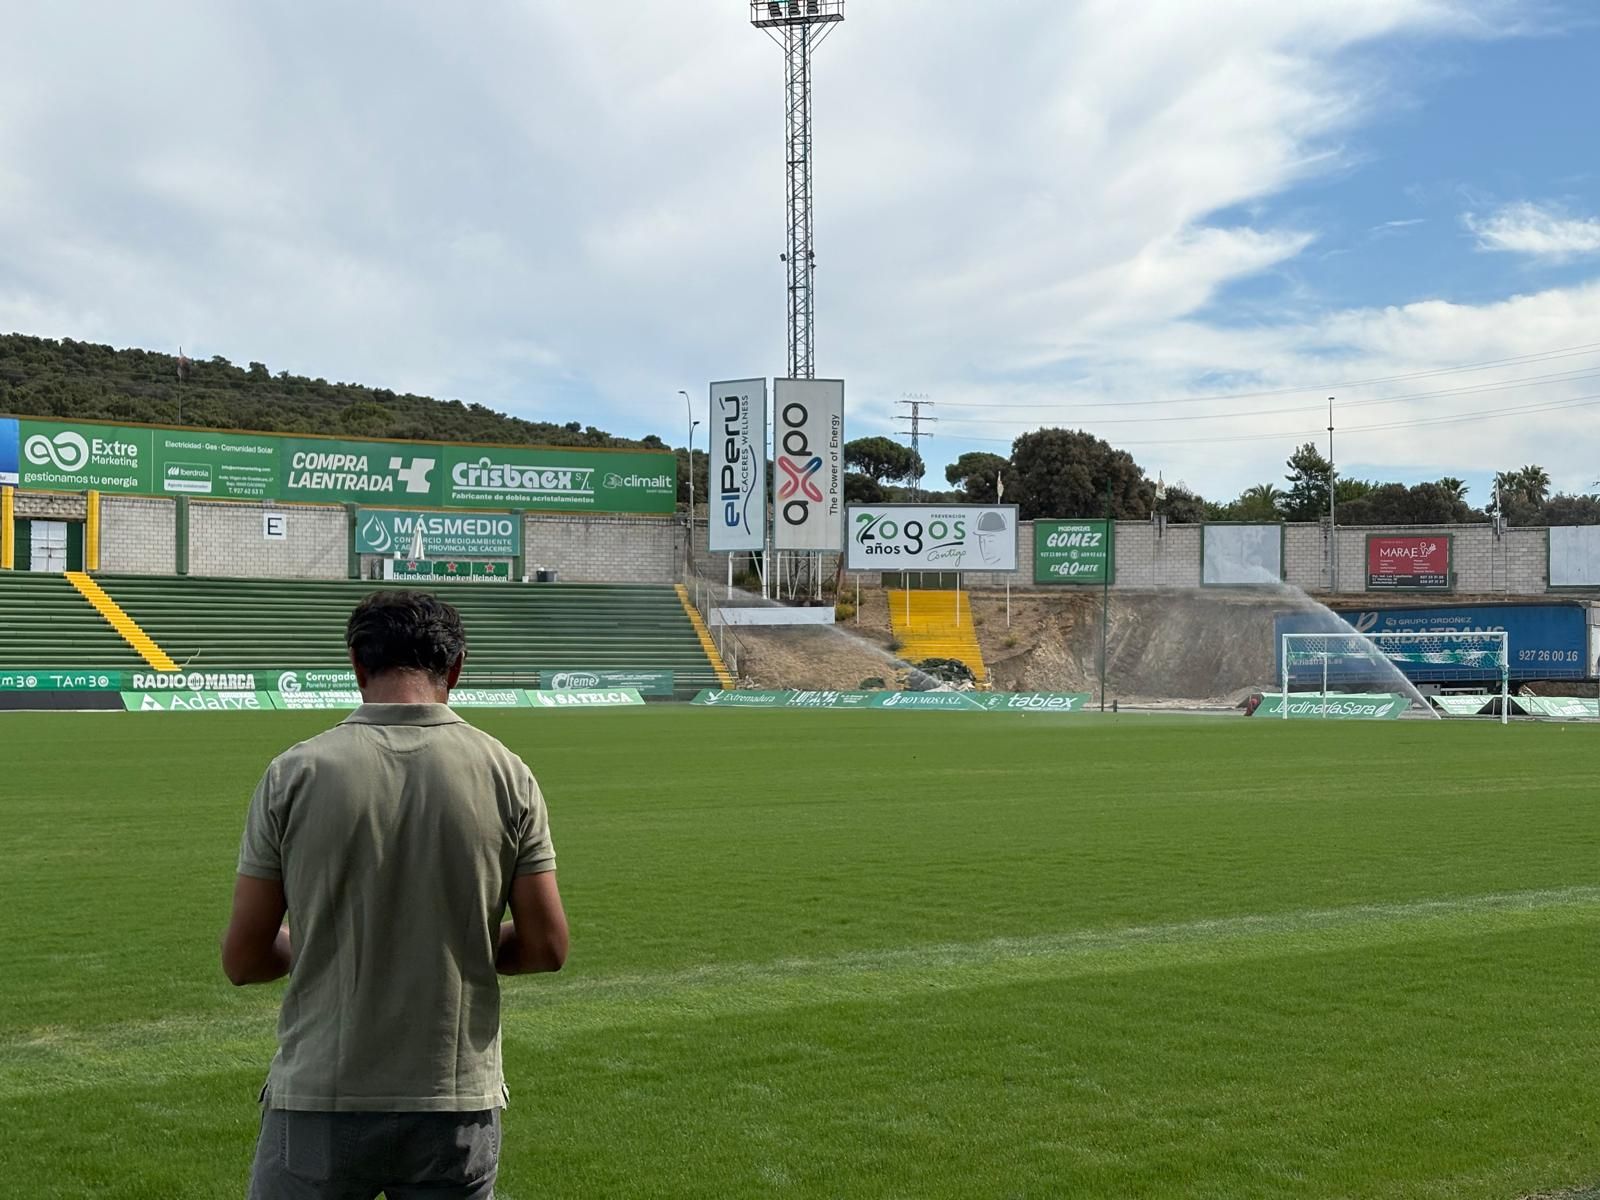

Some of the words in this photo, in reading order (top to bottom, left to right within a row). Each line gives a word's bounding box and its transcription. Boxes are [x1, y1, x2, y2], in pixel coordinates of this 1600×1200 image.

[742, 395, 750, 446] WELLNESS
[829, 413, 841, 451] Energy
[92, 438, 138, 457] Extre
[165, 440, 203, 450] Electricidad
[205, 443, 218, 452] Gas
[221, 444, 257, 454] Comunidad
[257, 446, 274, 455] Solar
[92, 455, 138, 469] Marketing
[292, 451, 368, 472] COMPRA
[829, 451, 838, 462] of
[778, 403, 823, 526] axpo
[24, 471, 89, 485] gestionamos
[89, 475, 101, 485] tu
[101, 476, 138, 490] energía
[180, 469, 209, 478] Iberdrola
[829, 462, 838, 493] Power
[288, 471, 393, 493] LAENTRADA
[623, 475, 673, 489] climalit
[452, 492, 493, 502] Fabricante
[494, 494, 504, 502] de
[504, 495, 531, 503] dobles
[531, 496, 595, 504] acristalamientos
[829, 494, 837, 516] The
[267, 517, 283, 536] E
[393, 514, 513, 536] MÁSMEDIO
[444, 537, 513, 546] MEDIOAMBIENTE
[1046, 533, 1103, 547] GOMEZ
[428, 544, 466, 552] PROVINCIA
[468, 545, 478, 553] DE
[865, 542, 901, 555] años
[926, 549, 967, 568] Contigo
[393, 571, 432, 581] Heineken
[433, 573, 470, 582] Heineken
[472, 572, 508, 582] Heineken
[1398, 617, 1428, 625] GRUPO
[1519, 650, 1536, 661] 927
[1537, 650, 1550, 661] 26
[1551, 651, 1564, 661] 00
[1566, 651, 1578, 662] 16
[133, 673, 187, 689] RADIO
[204, 673, 256, 690] MARCA
[169, 692, 262, 710] Adarve
[448, 690, 476, 702] ado
[476, 690, 517, 703] Plantel
[555, 691, 634, 705] SATELCA
[723, 693, 776, 704] Extremadura
[1007, 693, 1078, 708] tabiex
